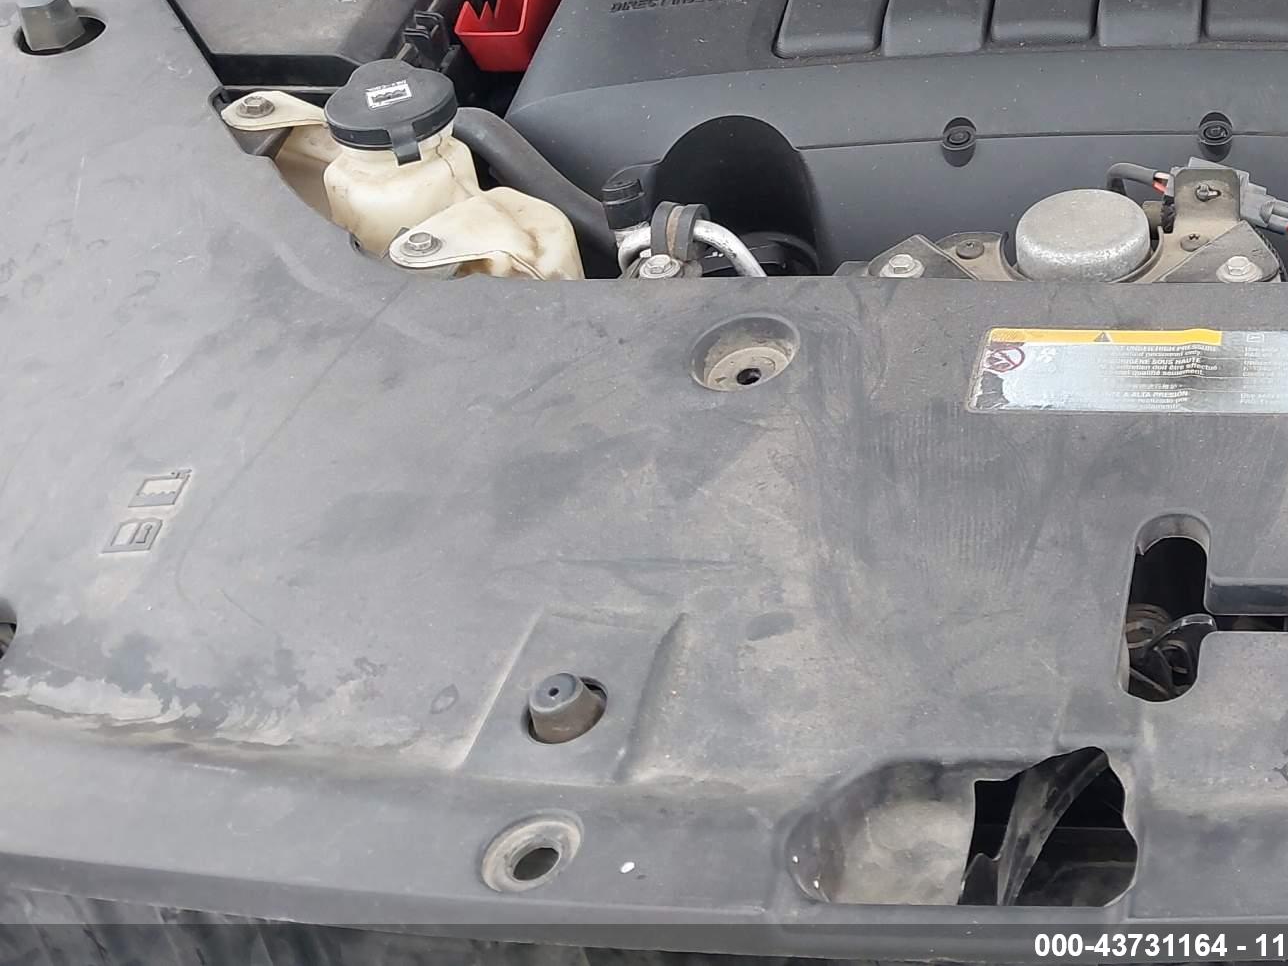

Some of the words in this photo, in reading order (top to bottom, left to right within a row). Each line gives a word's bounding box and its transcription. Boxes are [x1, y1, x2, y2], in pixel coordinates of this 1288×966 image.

[1178, 343, 1217, 352] PRESSURE
[1175, 357, 1202, 365] HAUTE
[1186, 362, 1218, 371] effectué
